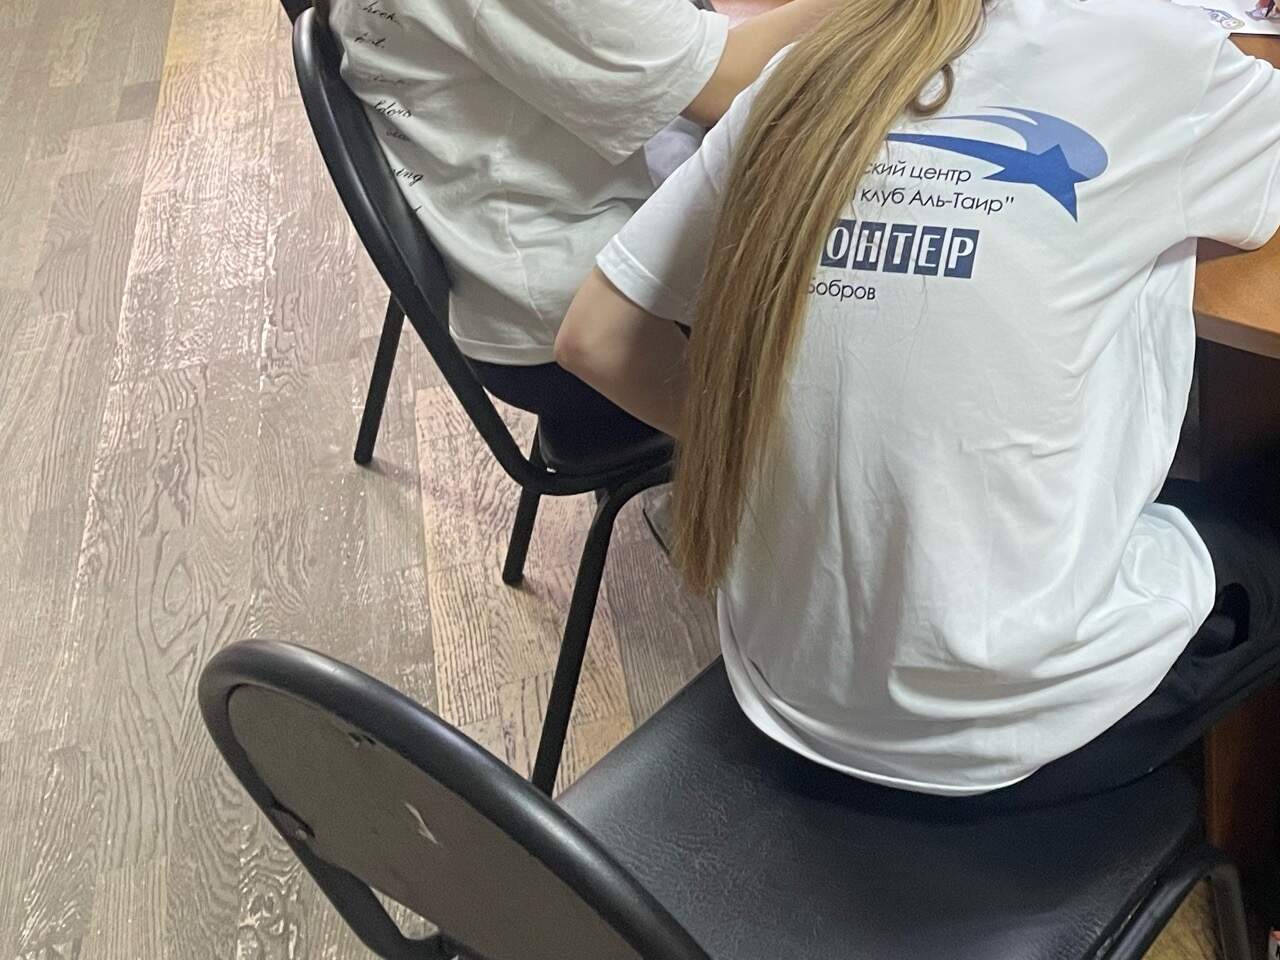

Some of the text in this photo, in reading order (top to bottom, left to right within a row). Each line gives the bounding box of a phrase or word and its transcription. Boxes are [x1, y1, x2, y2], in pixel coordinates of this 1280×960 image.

[909, 164, 972, 185] центр
[860, 187, 1015, 215] клуб Аль-Таир"
[825, 226, 976, 270] ОНТЕР
